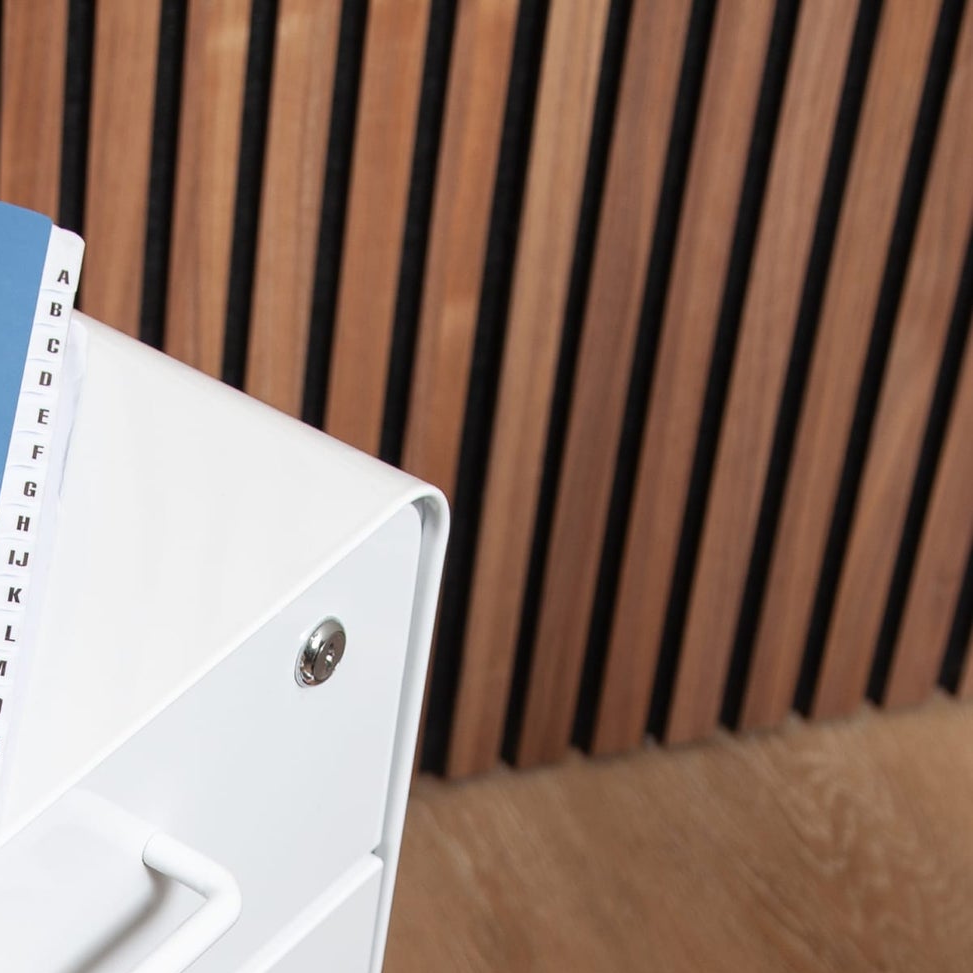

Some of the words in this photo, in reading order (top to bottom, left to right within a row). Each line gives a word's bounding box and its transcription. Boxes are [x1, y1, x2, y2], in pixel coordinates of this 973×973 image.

[57, 269, 70, 285] A
[49, 301, 63, 317] B
[47, 338, 60, 354] C
[39, 371, 52, 387] D
[37, 408, 50, 425] E
[31, 444, 44, 460] F
[23, 481, 37, 498] G
[16, 515, 31, 532] H
[8, 549, 29, 567] IJ
[7, 586, 22, 604] K
[4, 625, 16, 642] L
